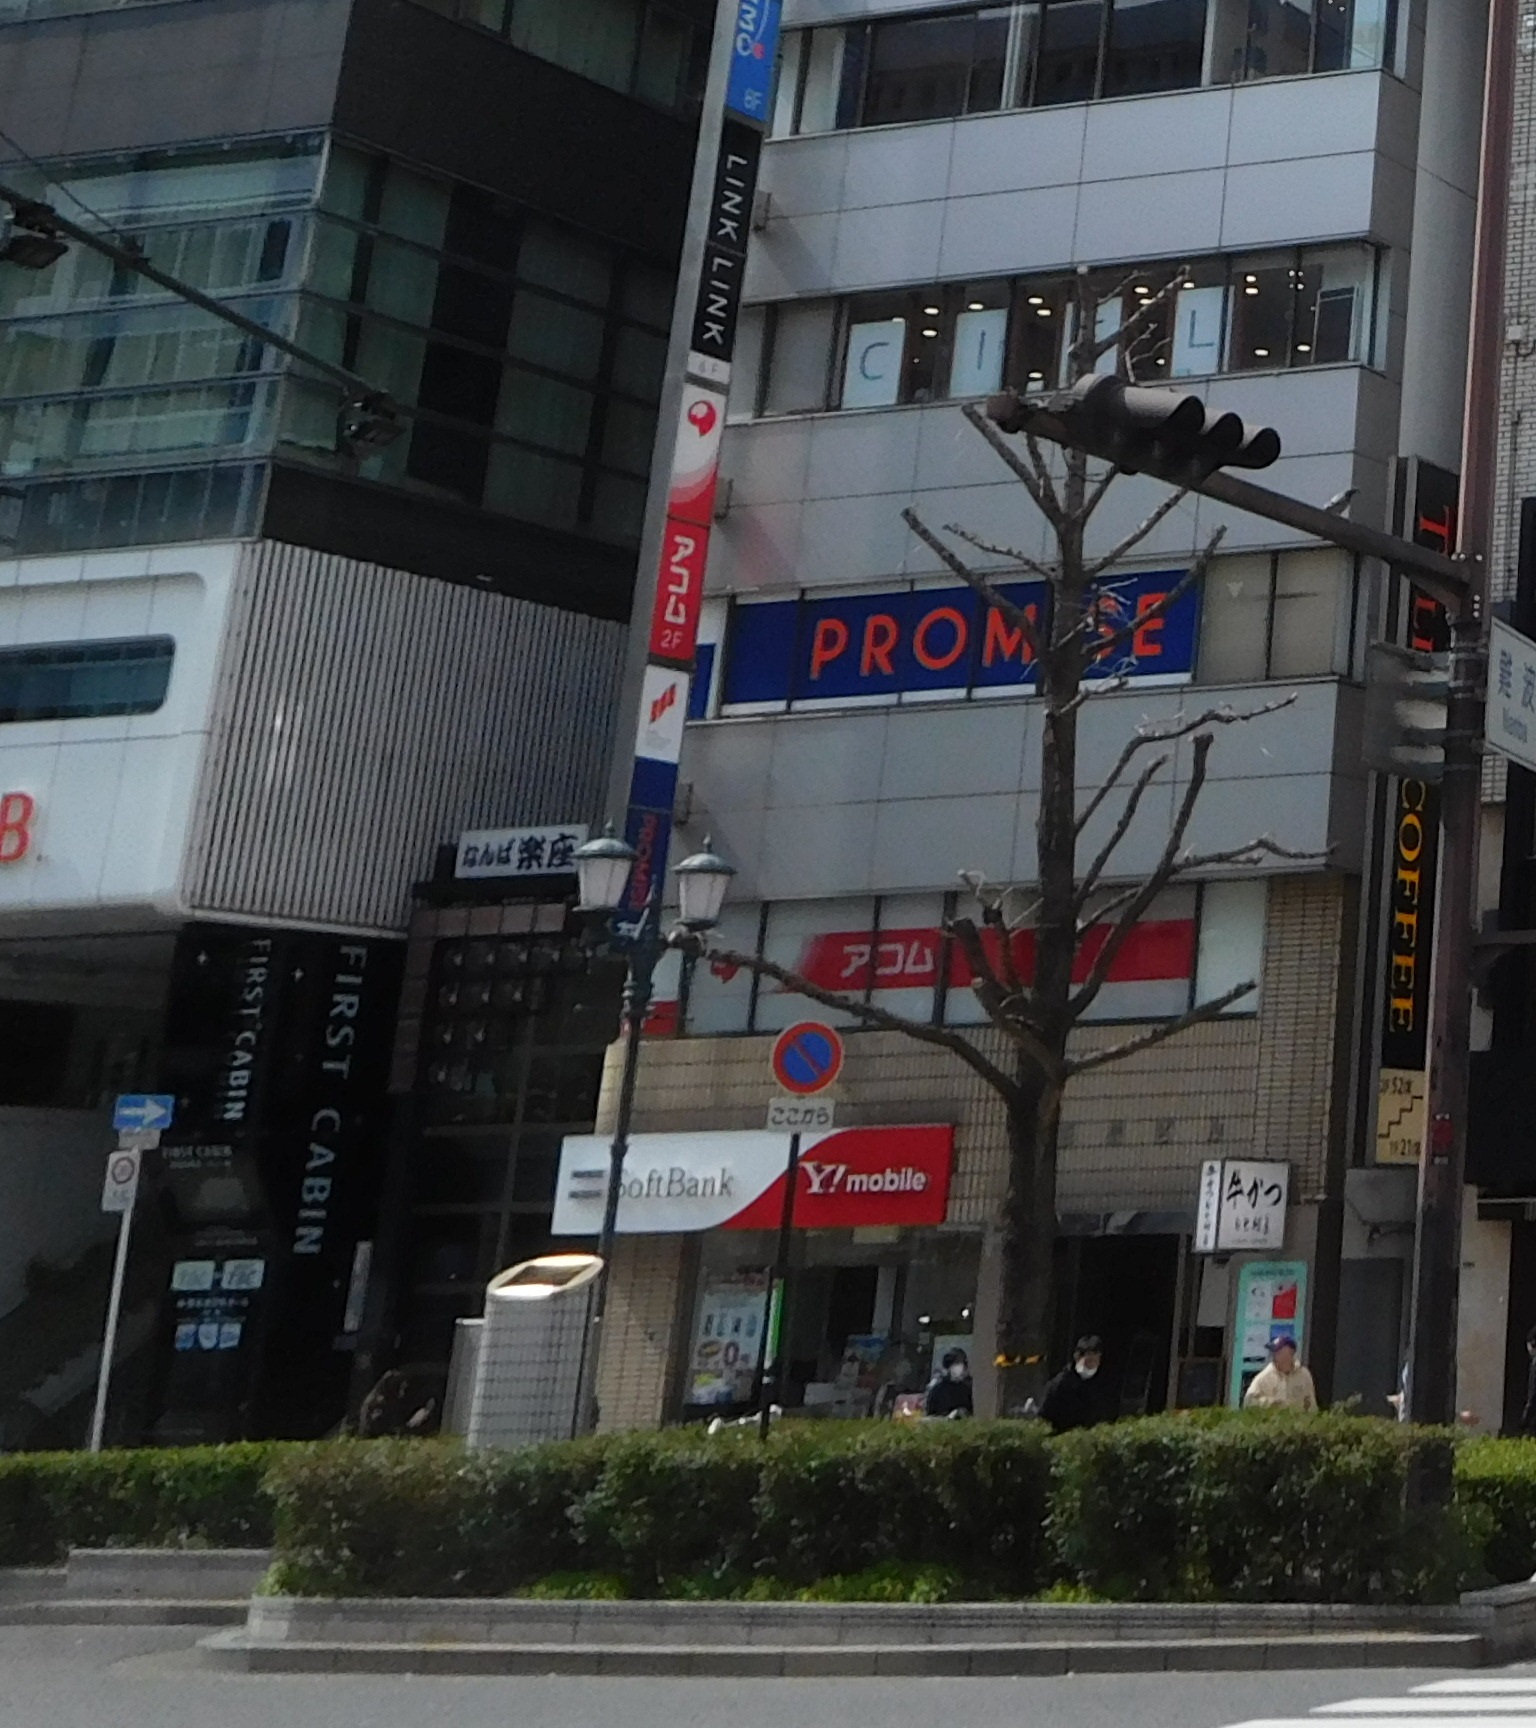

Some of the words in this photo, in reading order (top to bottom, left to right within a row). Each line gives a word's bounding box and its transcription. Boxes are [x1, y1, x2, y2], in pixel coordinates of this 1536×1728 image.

[721, 154, 748, 242] LINK
[702, 258, 733, 346] LINK
[664, 535, 695, 625] アコム
[660, 629, 683, 649] 2F
[810, 592, 1169, 680] PROMSE
[240, 938, 272, 1020] FIRST
[841, 940, 934, 978] アコム
[321, 943, 368, 1079] FIRST
[222, 1029, 256, 1123] CABIN
[770, 1105, 831, 1126] ここから
[292, 1108, 341, 1254] CABIN
[1226, 1169, 1283, 1210] 牛かつ
